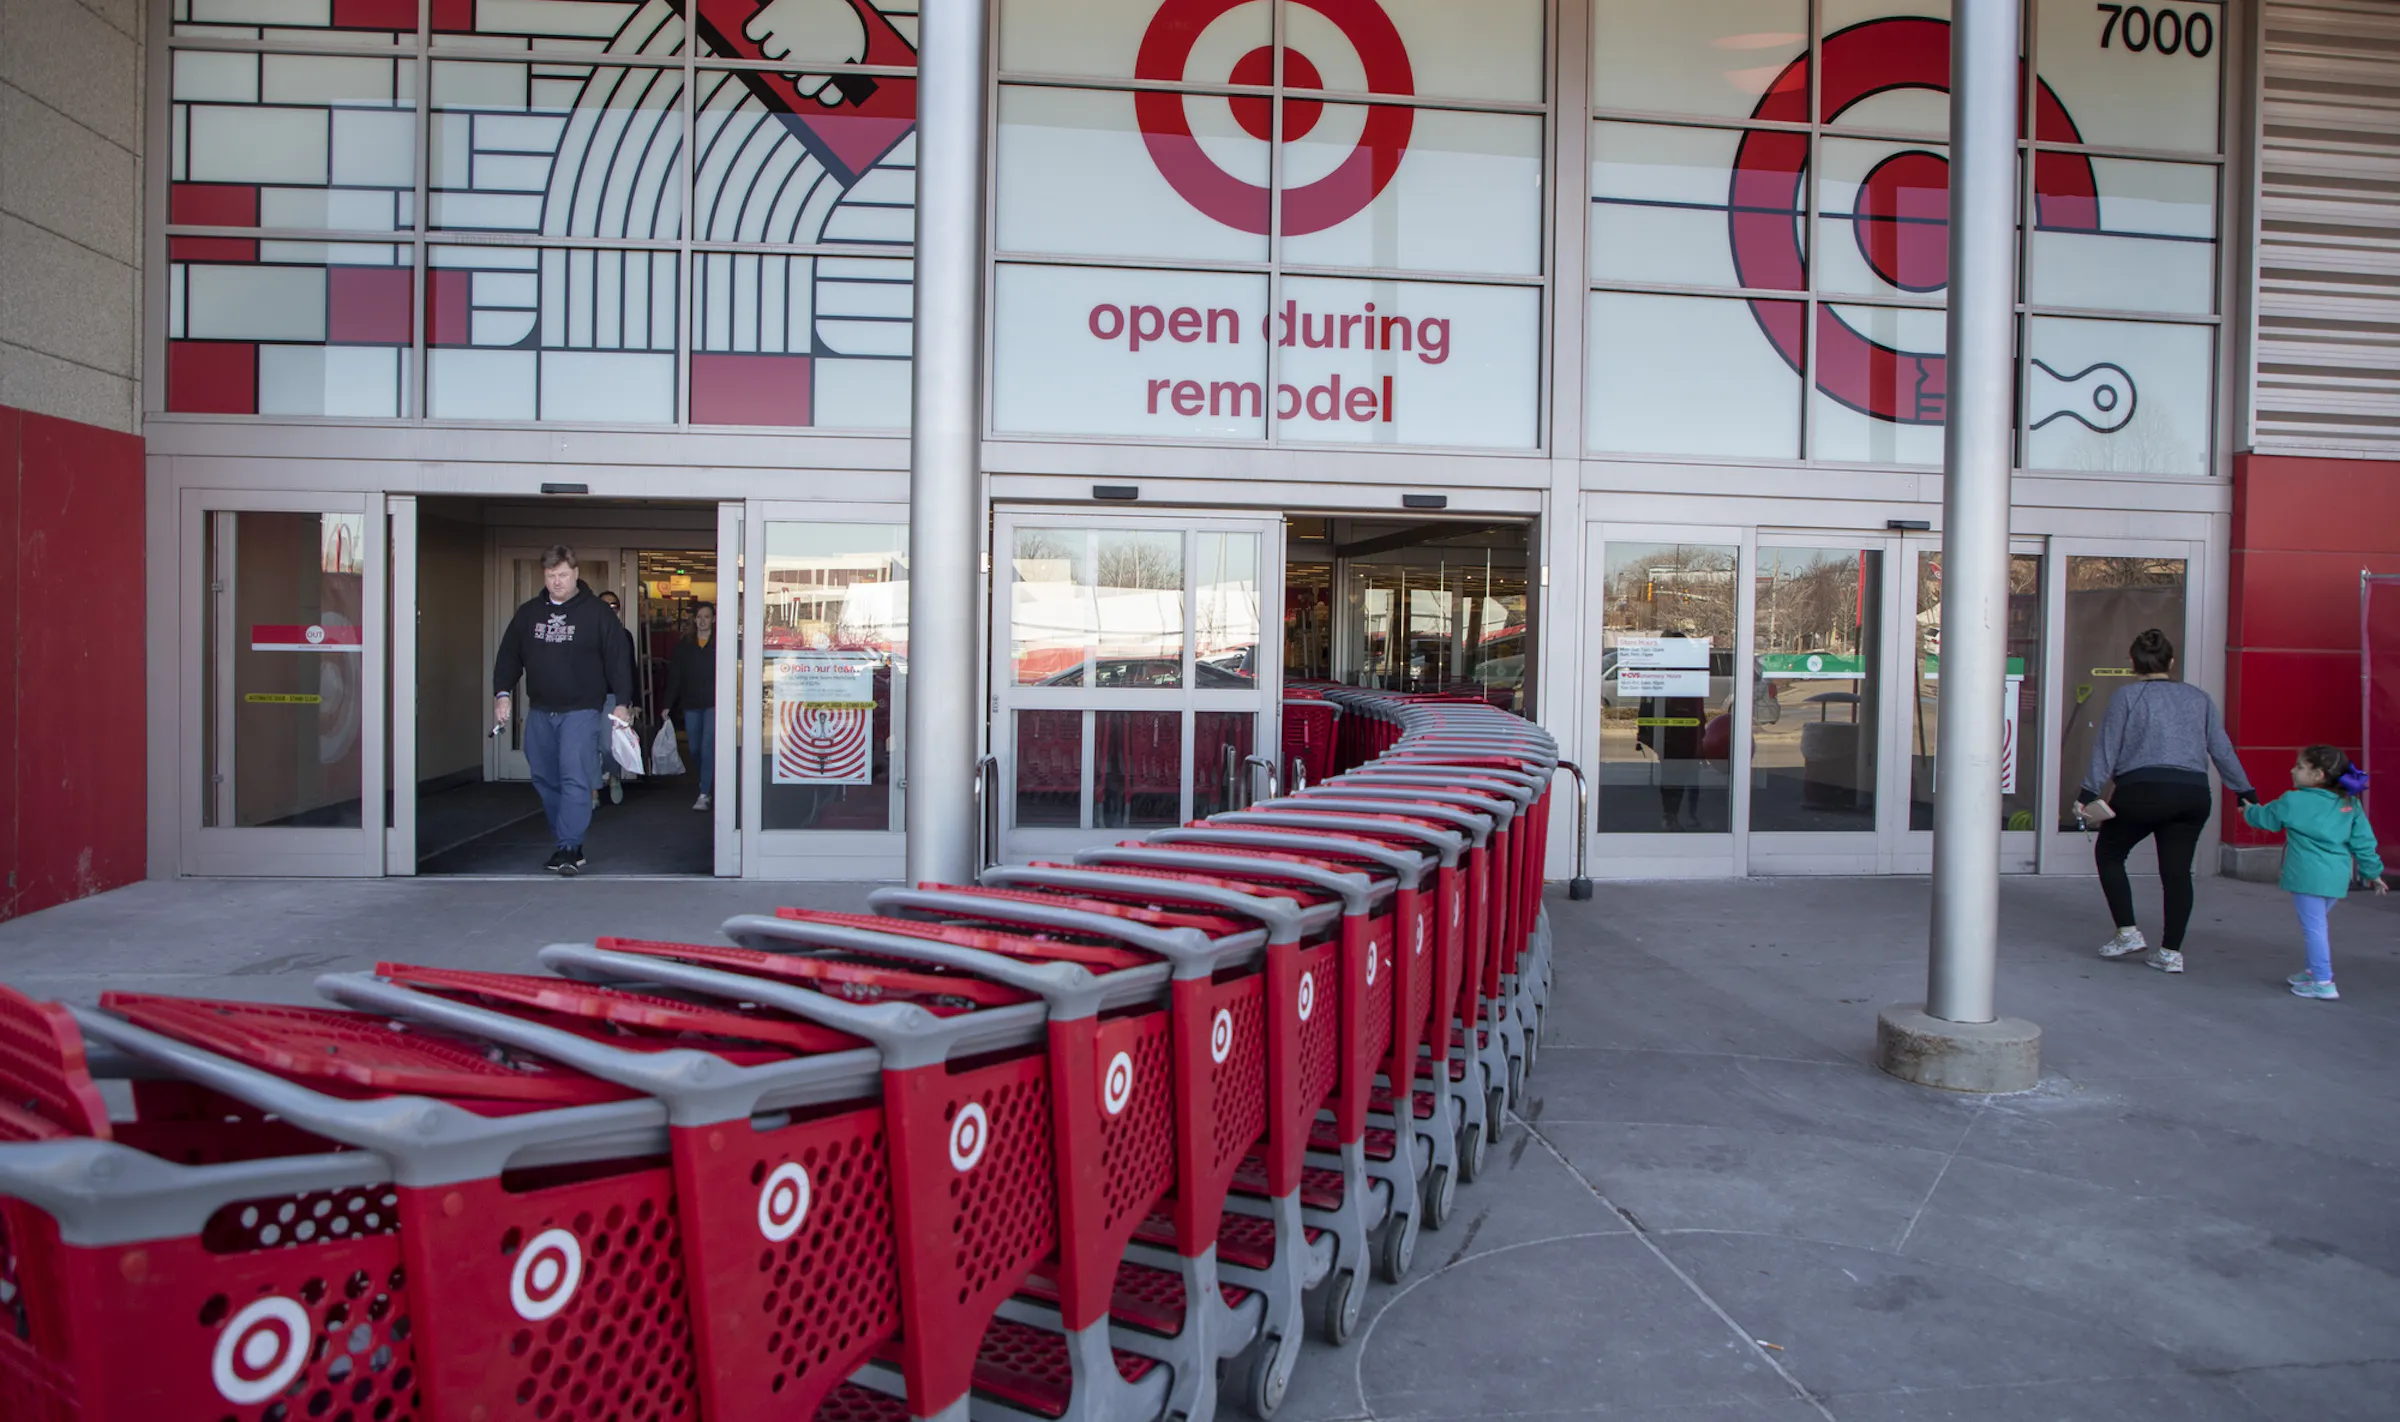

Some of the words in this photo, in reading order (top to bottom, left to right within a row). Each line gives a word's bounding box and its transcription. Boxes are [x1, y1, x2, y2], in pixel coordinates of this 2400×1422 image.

[2097, 3, 2213, 58] 7000
[1088, 301, 1239, 352] open
[1261, 298, 1451, 364] during
[1146, 374, 1393, 423] remodel
[791, 663, 810, 674] join
[814, 665, 830, 673] our
